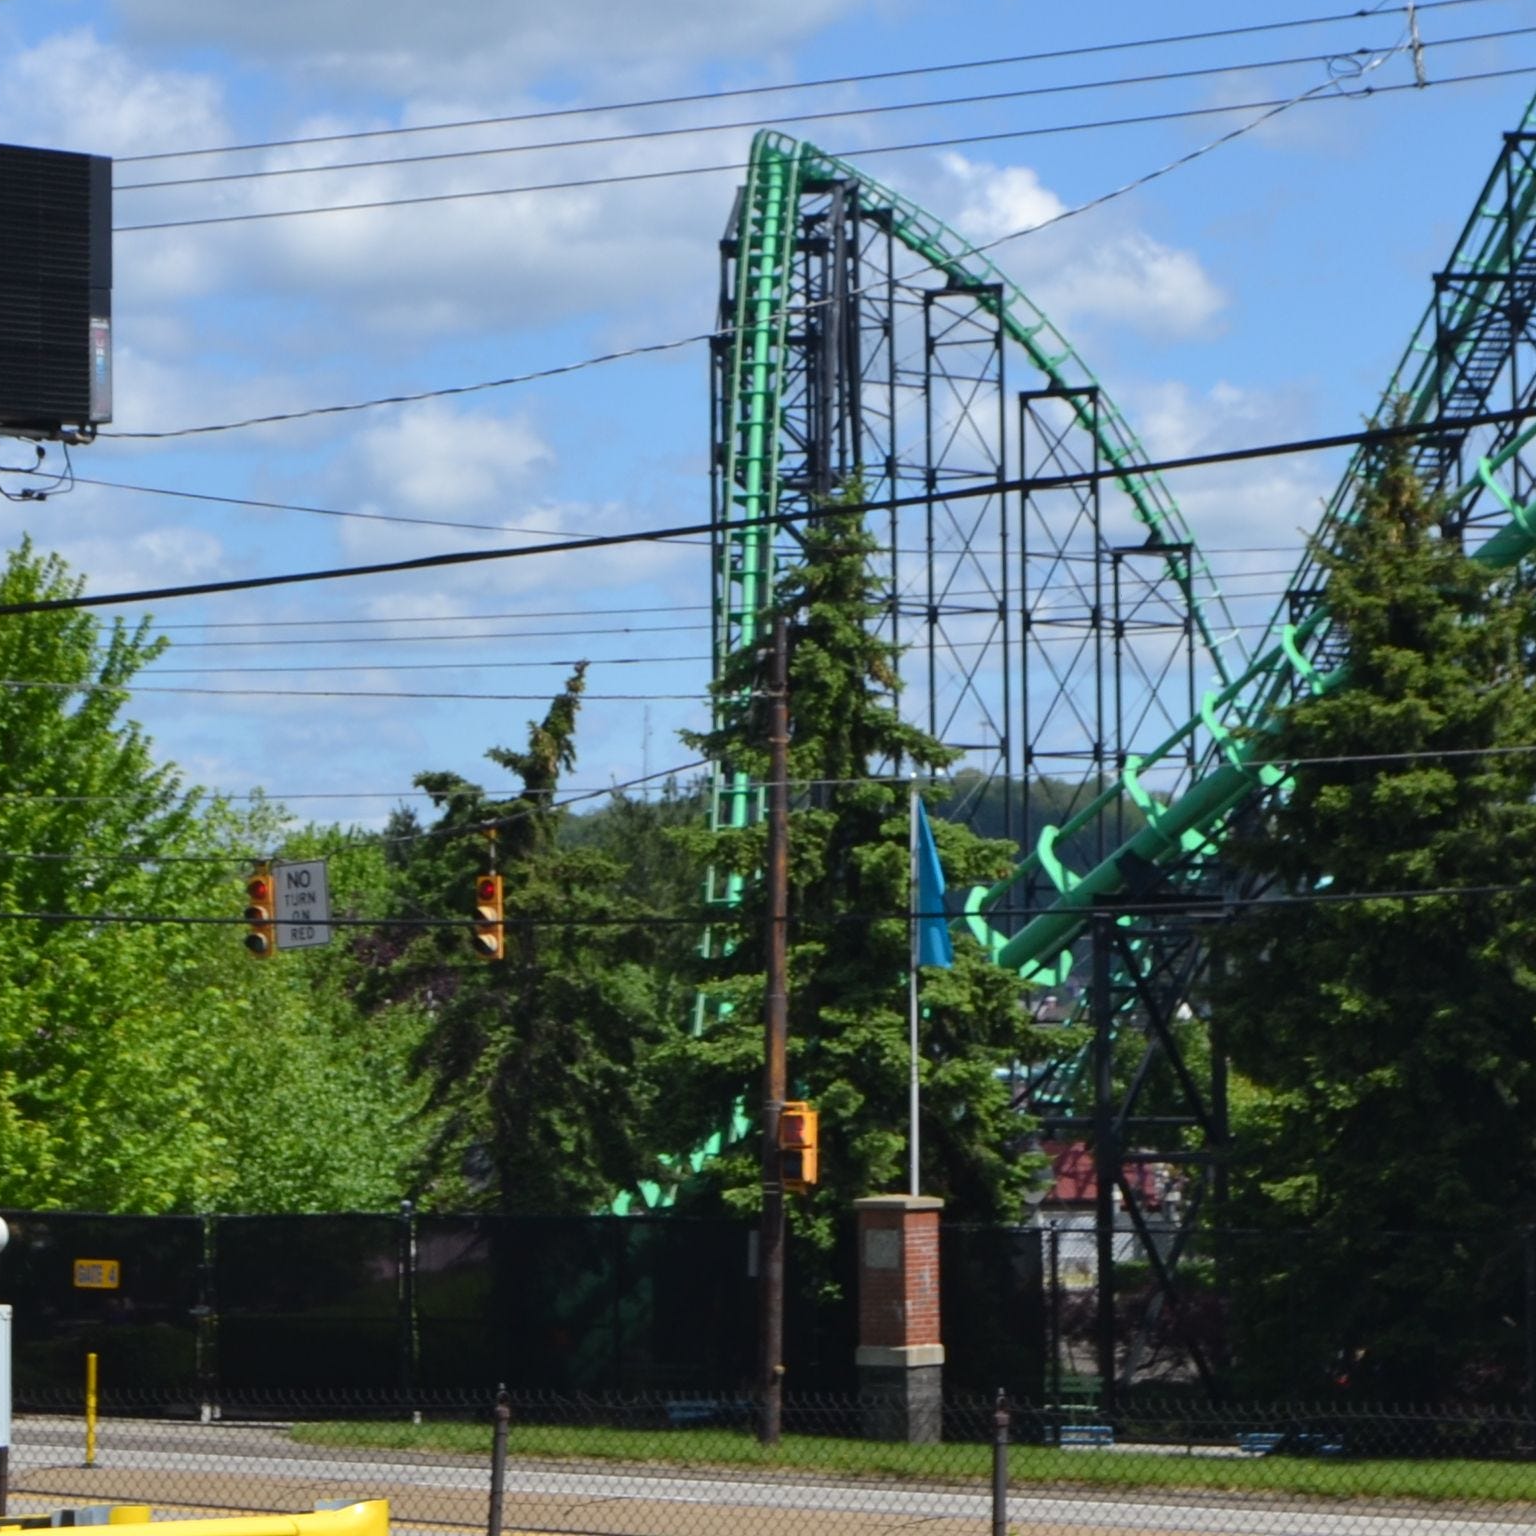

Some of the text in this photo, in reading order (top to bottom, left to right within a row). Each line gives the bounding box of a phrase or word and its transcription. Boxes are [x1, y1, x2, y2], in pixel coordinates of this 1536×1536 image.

[287, 870, 311, 889] NO
[284, 891, 316, 906] TURN
[292, 910, 311, 921] ON
[290, 926, 315, 941] RED
